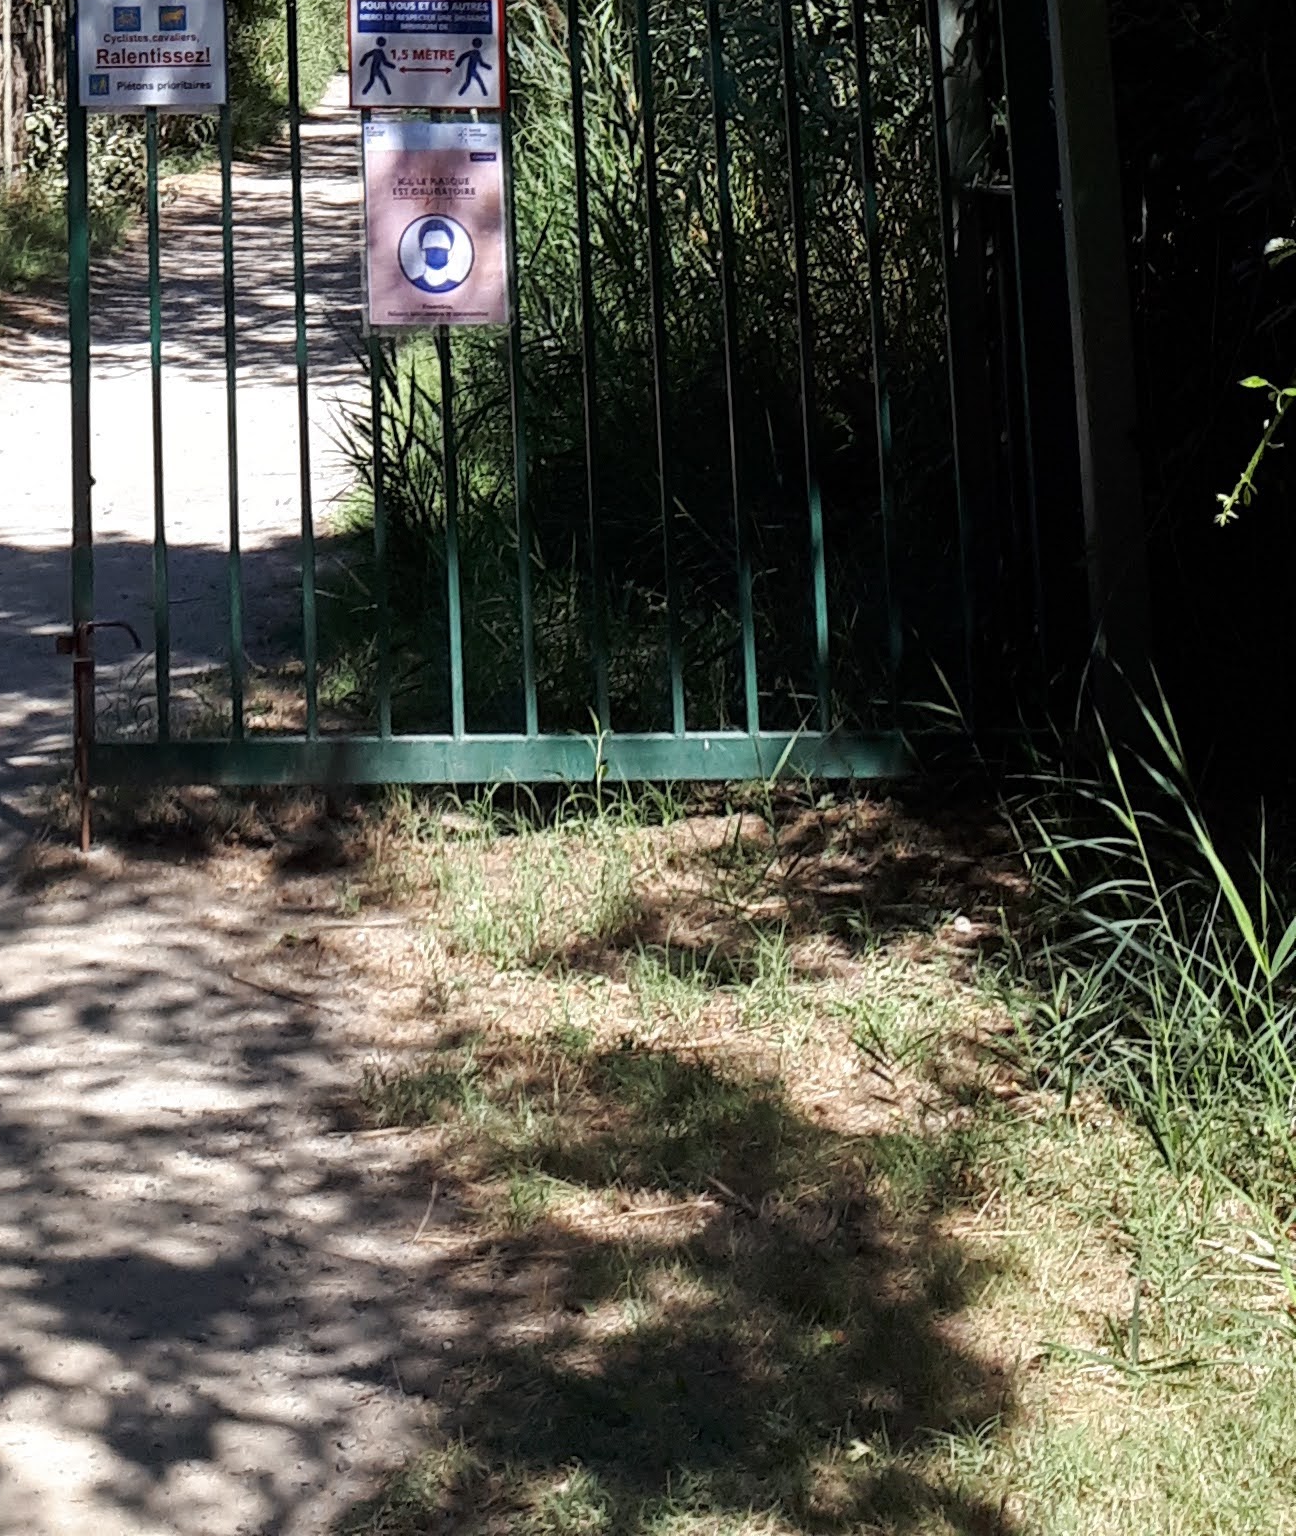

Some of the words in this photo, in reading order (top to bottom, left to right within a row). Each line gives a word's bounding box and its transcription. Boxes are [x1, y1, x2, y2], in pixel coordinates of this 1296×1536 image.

[360, 1, 387, 11] POUR
[389, 1, 416, 11] VOUS
[418, 1, 430, 11] ET
[431, 1, 449, 11] LES
[452, 1, 489, 11] AUTRES
[96, 47, 210, 64] Ralentissez!
[390, 49, 409, 61] 1,5
[116, 81, 154, 91] Piétons
[157, 81, 212, 91] prioritaires
